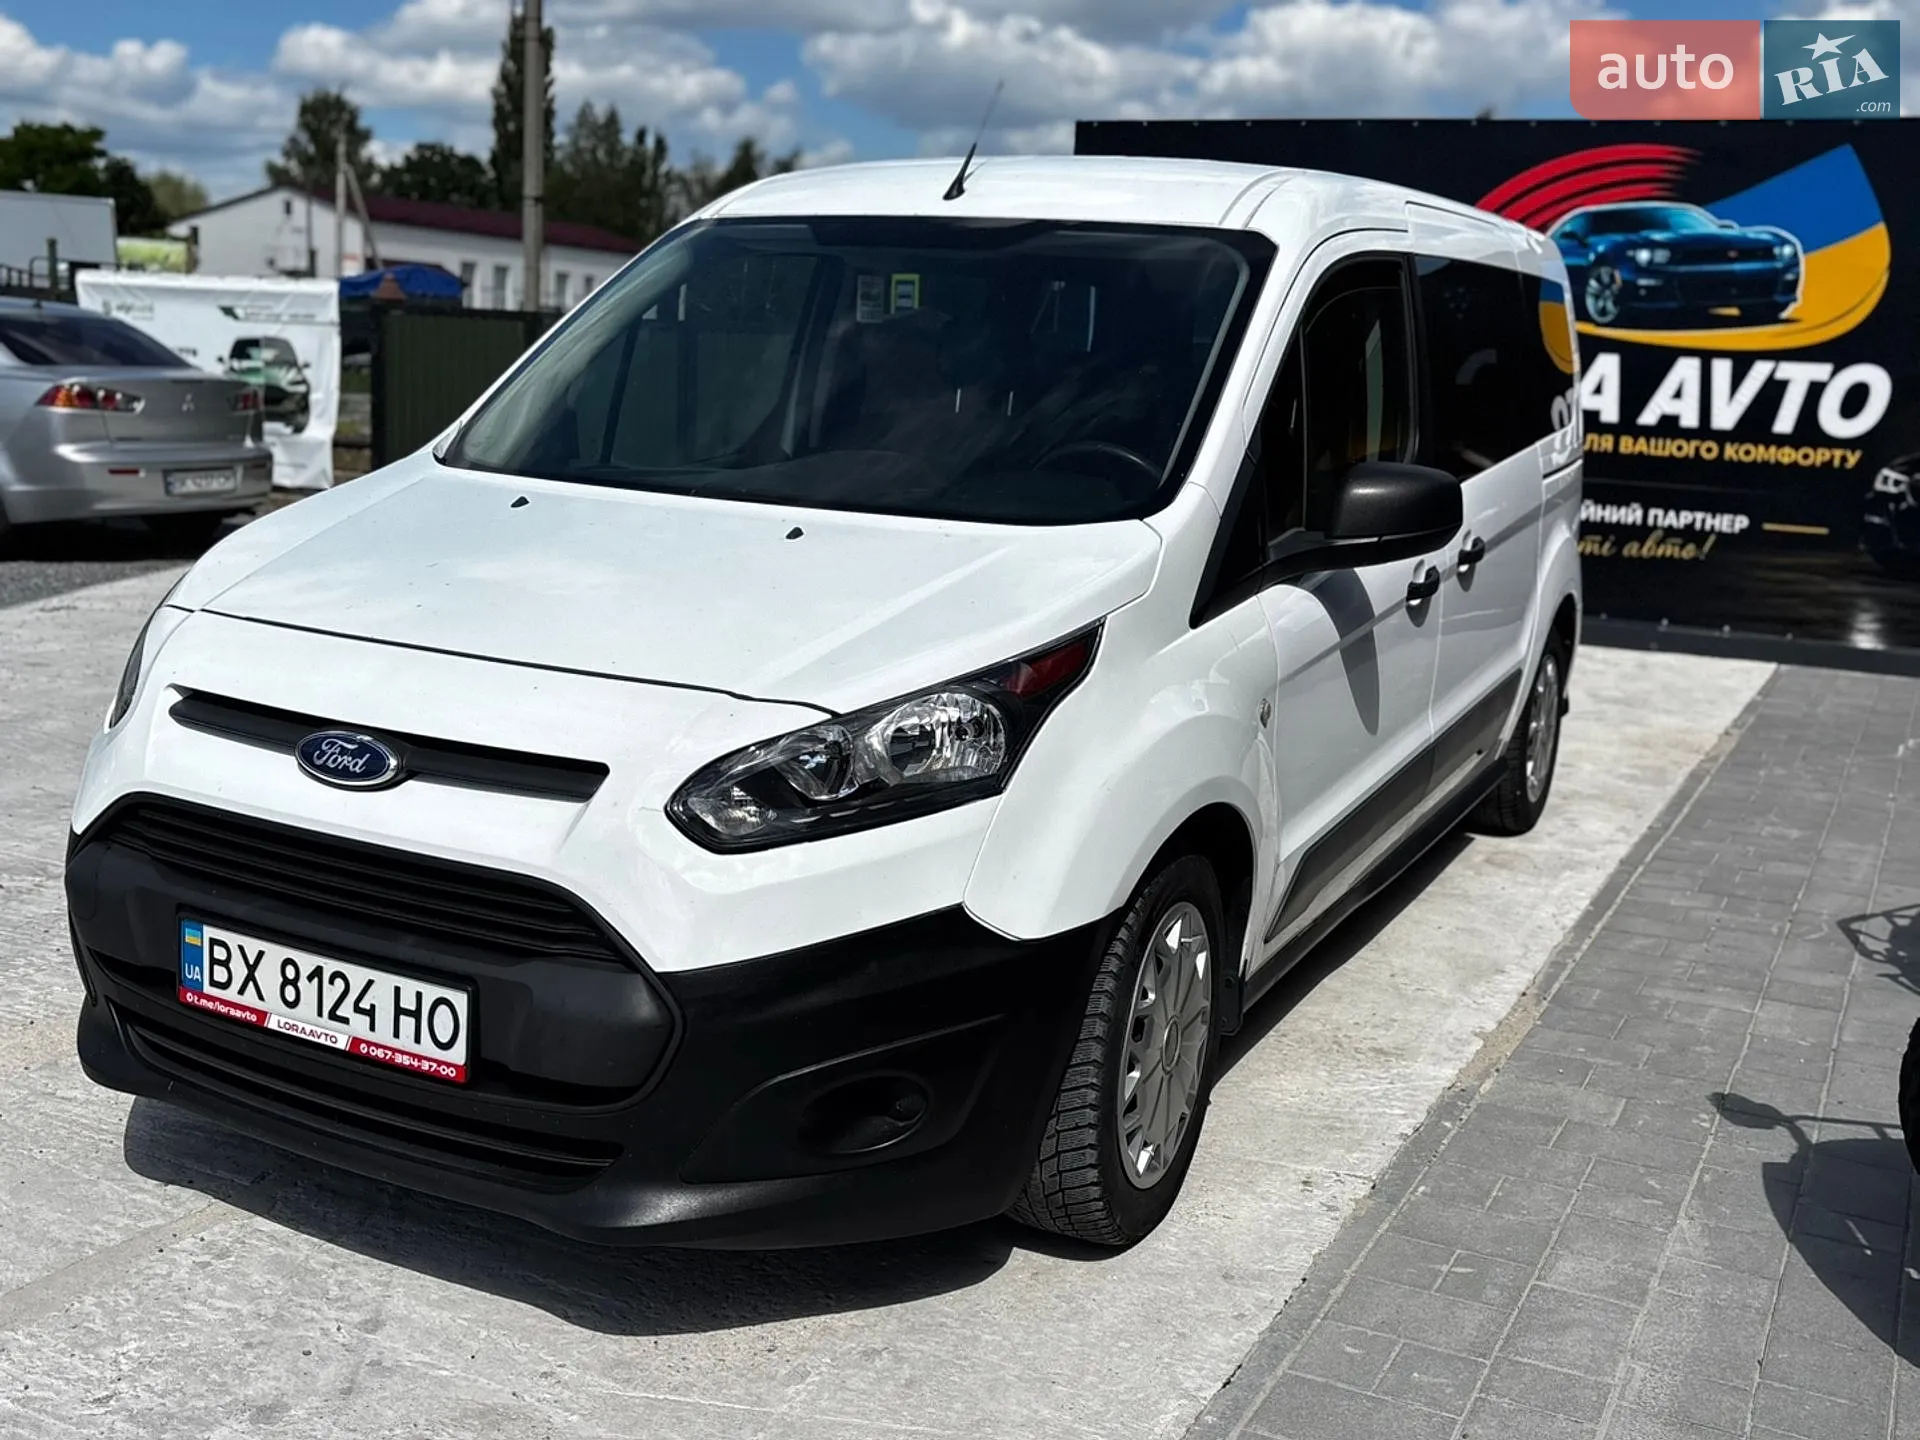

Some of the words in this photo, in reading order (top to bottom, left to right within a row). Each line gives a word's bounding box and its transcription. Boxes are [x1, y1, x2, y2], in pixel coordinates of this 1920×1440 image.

[1580, 352, 1621, 424] A
[1636, 356, 1893, 439] AVTO
[1583, 432, 1614, 453] ЛЯ
[1618, 435, 1720, 461] ВАШОГО
[1723, 441, 1863, 470] КОМФОРТУ
[1580, 499, 1644, 526] ЙНИЙ
[1647, 506, 1750, 534] ПАРТНЕР
[1577, 533, 1617, 557] ті
[313, 738, 371, 773] Ford
[185, 962, 202, 982] UA
[208, 936, 266, 1002] BX
[280, 957, 376, 1033] 8124
[393, 985, 460, 1051] HO
[277, 1018, 338, 1045] LORAAVTO
[368, 1046, 457, 1078] 067-354-37-00
